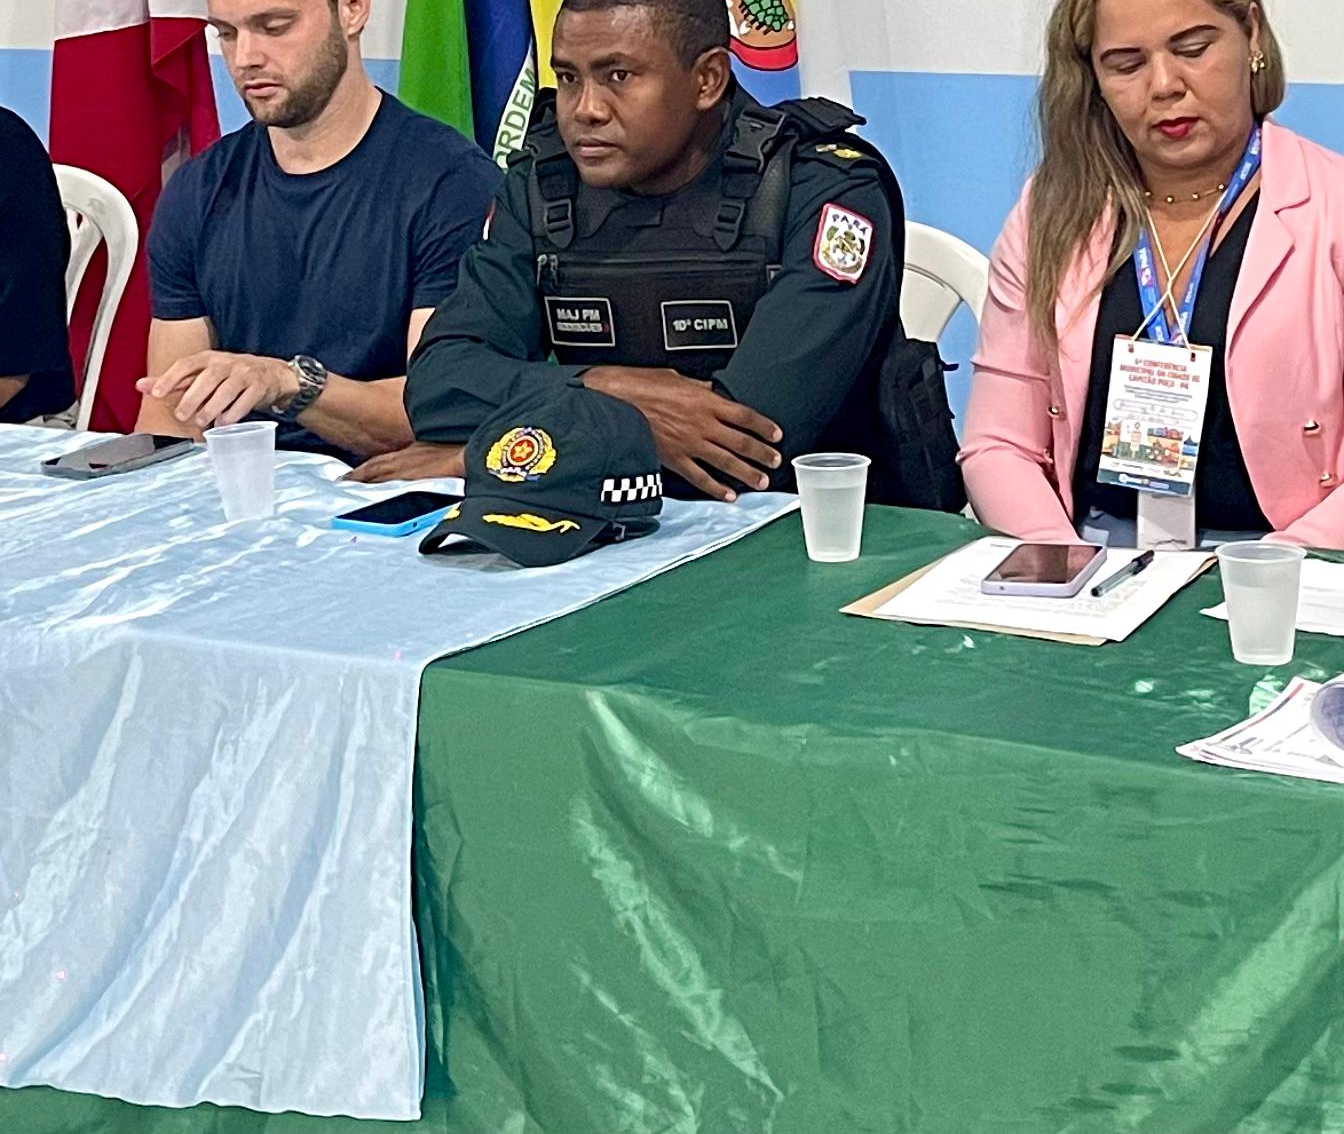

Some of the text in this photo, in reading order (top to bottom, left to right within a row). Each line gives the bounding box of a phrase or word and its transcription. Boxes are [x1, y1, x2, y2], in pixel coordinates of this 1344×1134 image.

[556, 308, 600, 321] MAJ PM
[694, 318, 729, 331] CIPM
